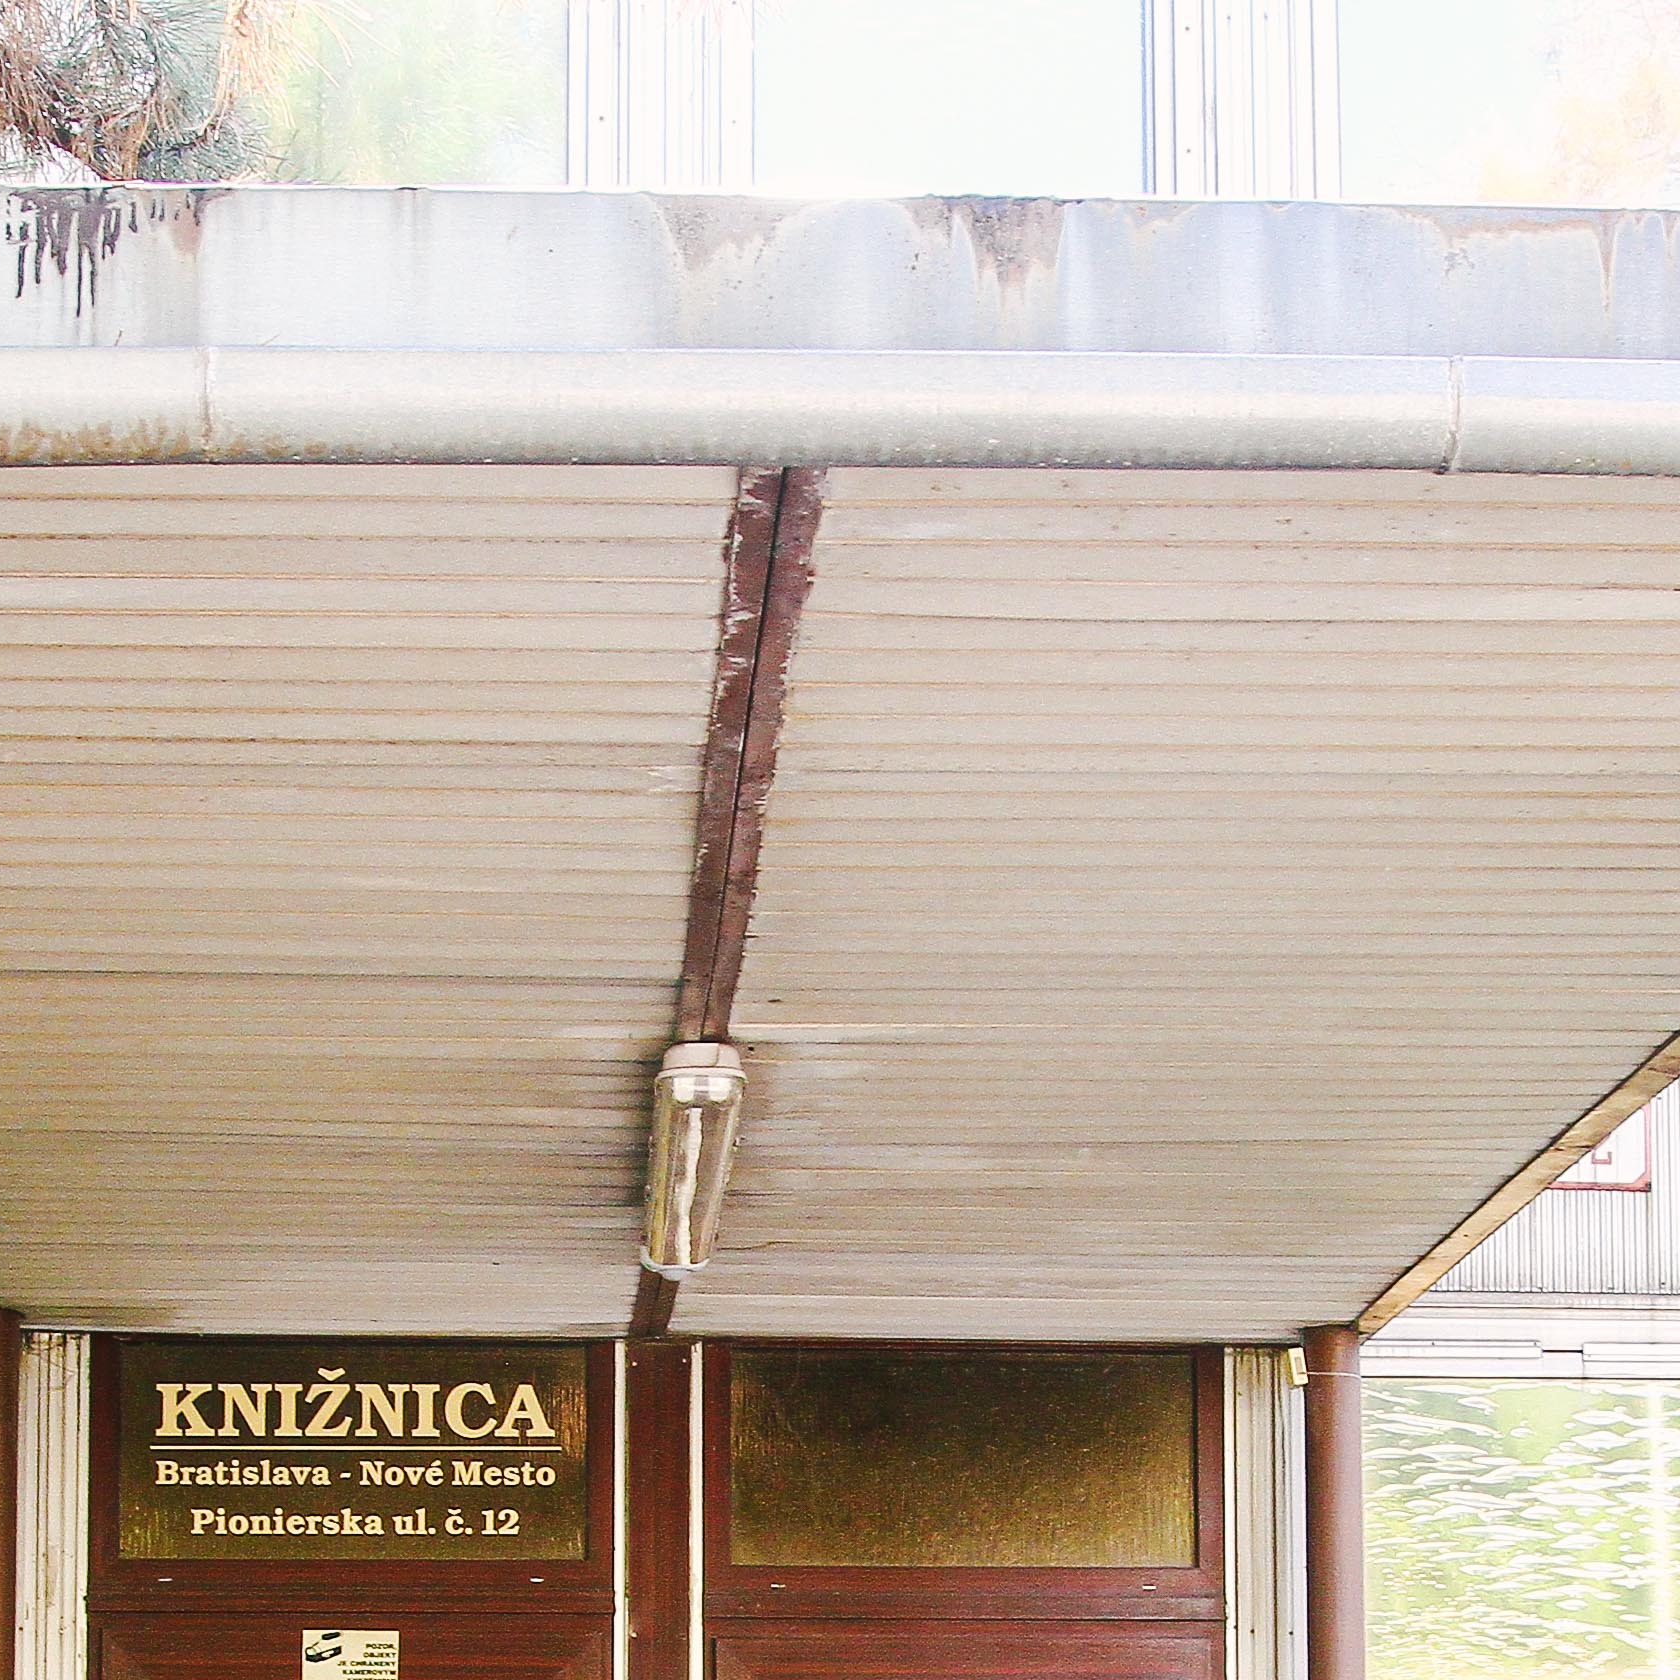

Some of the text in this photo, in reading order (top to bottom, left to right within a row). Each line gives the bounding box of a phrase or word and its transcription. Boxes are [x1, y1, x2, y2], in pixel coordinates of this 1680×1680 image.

[155, 1367, 556, 1438] KNIŽNICA
[155, 1459, 556, 1487] Bratislava - Nové Mesto
[190, 1508, 520, 1535] Pionierska ul. č. 12
